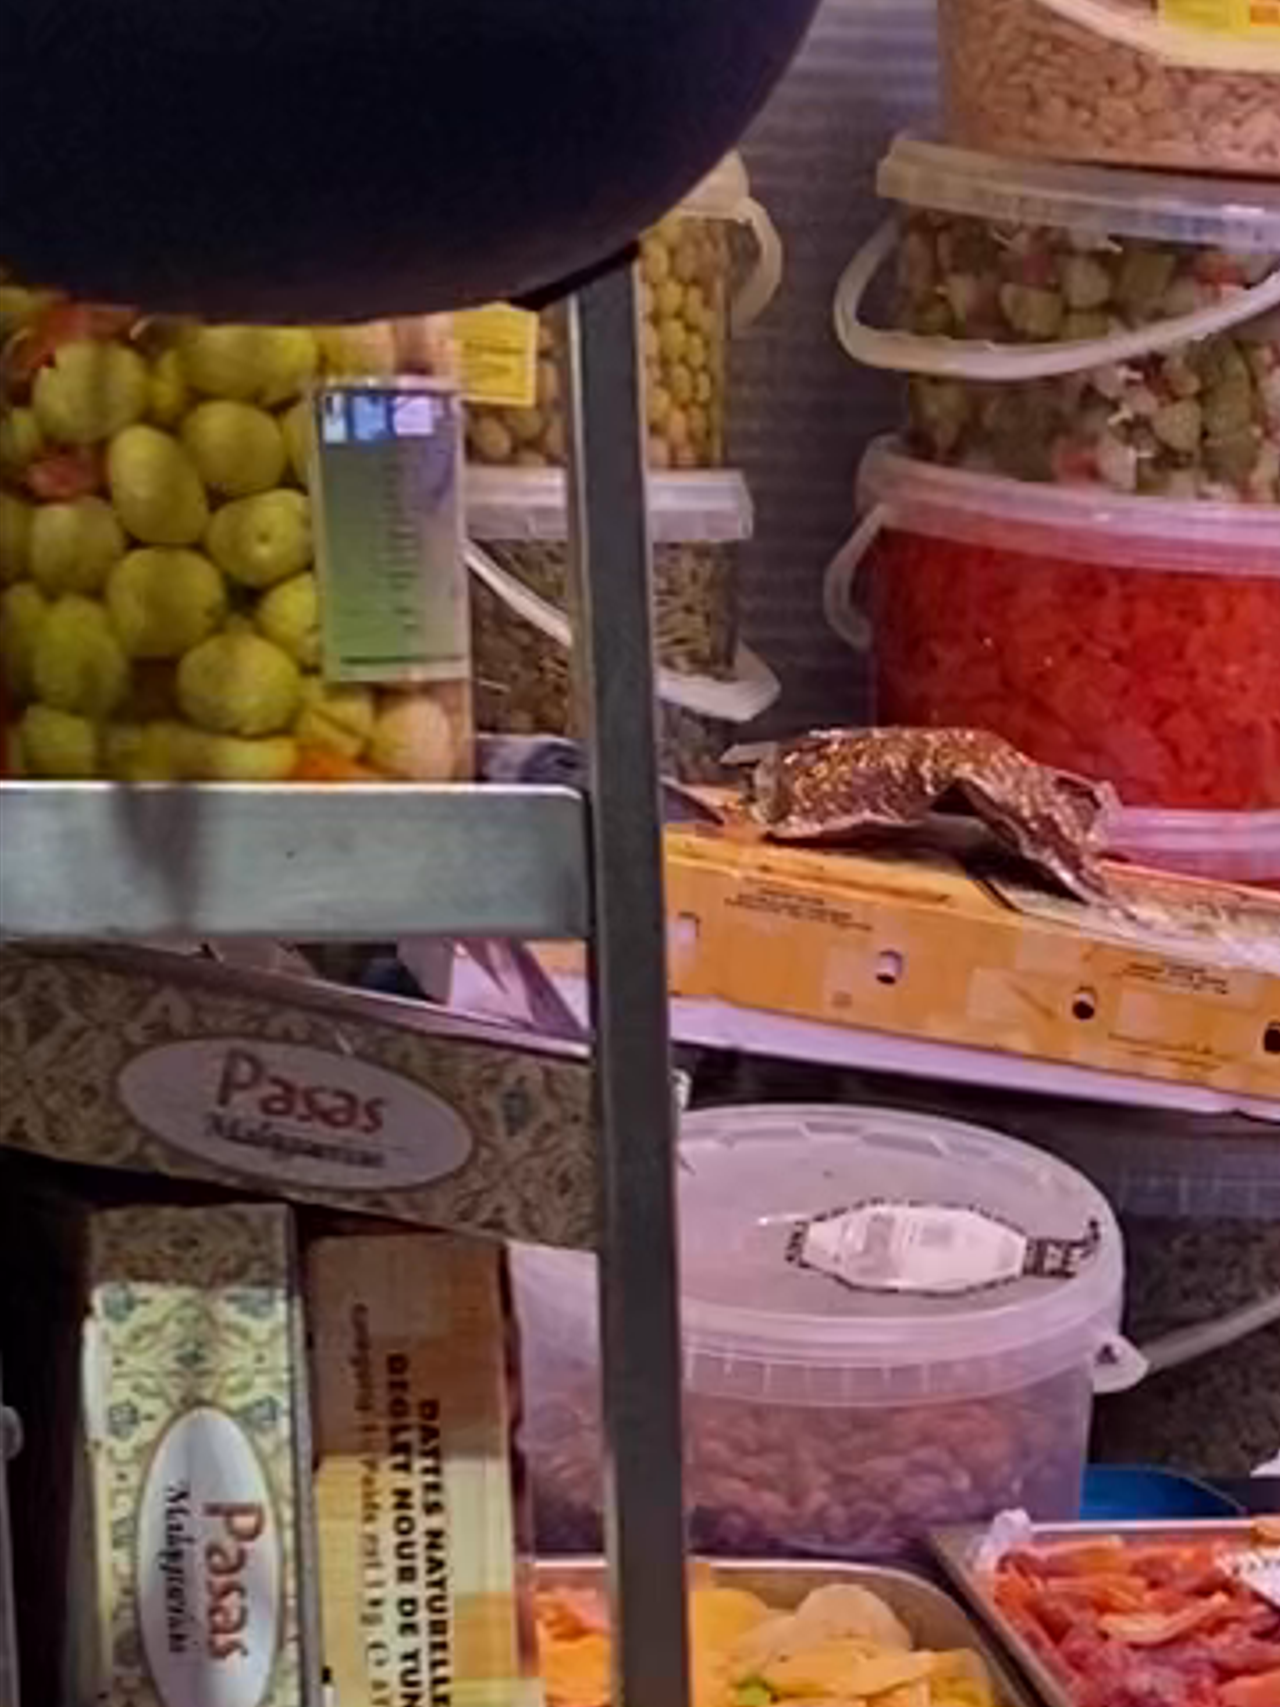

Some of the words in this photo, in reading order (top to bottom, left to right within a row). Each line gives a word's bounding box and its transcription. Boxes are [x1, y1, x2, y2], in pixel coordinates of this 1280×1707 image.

[217, 1046, 386, 1134] Pasas
[386, 1352, 414, 1475] DEGLET
[417, 1398, 446, 1517] DATTES
[202, 1501, 266, 1660] Pasas
[396, 1597, 421, 1637] DE
